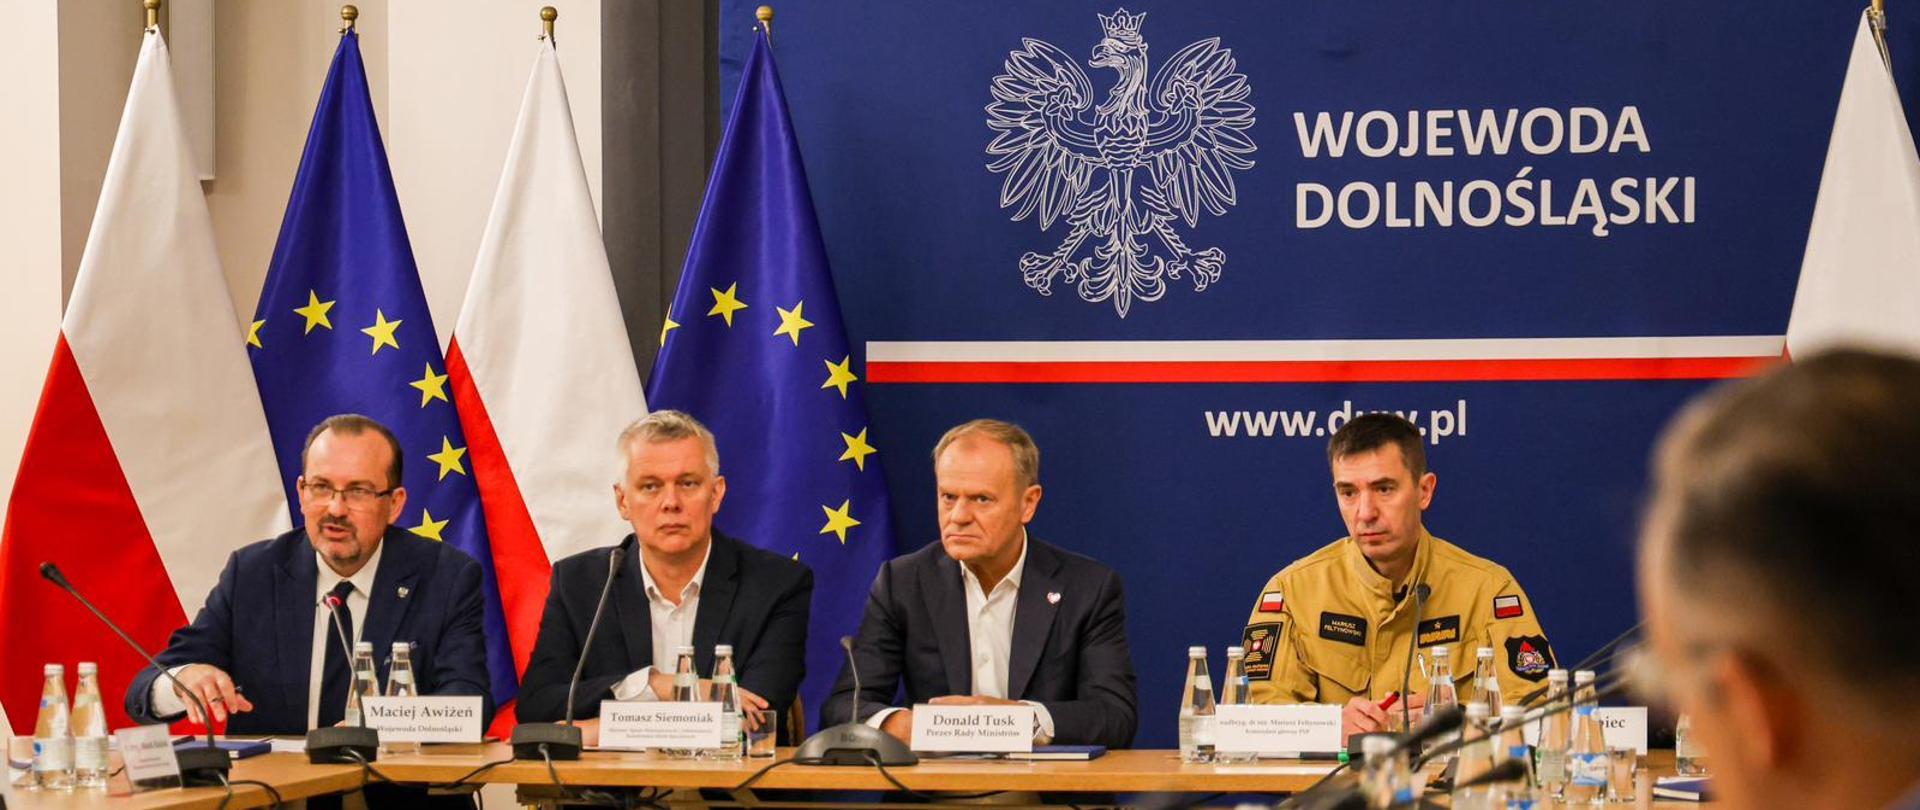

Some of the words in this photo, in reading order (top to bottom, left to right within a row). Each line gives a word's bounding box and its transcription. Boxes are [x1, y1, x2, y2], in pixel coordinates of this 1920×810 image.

[1293, 106, 1651, 158] WOJEWODA
[1296, 166, 1696, 237] DOLNOŚLĄSKI
[1205, 400, 1467, 445] www.d.pl
[370, 705, 416, 720] Maciej
[420, 705, 473, 718] Awiżeń
[610, 711, 652, 722] Tomasz
[655, 711, 714, 722] Siemoniak
[933, 714, 980, 726] Donald
[982, 714, 1016, 726] Tusk
[954, 728, 976, 739] Rady
